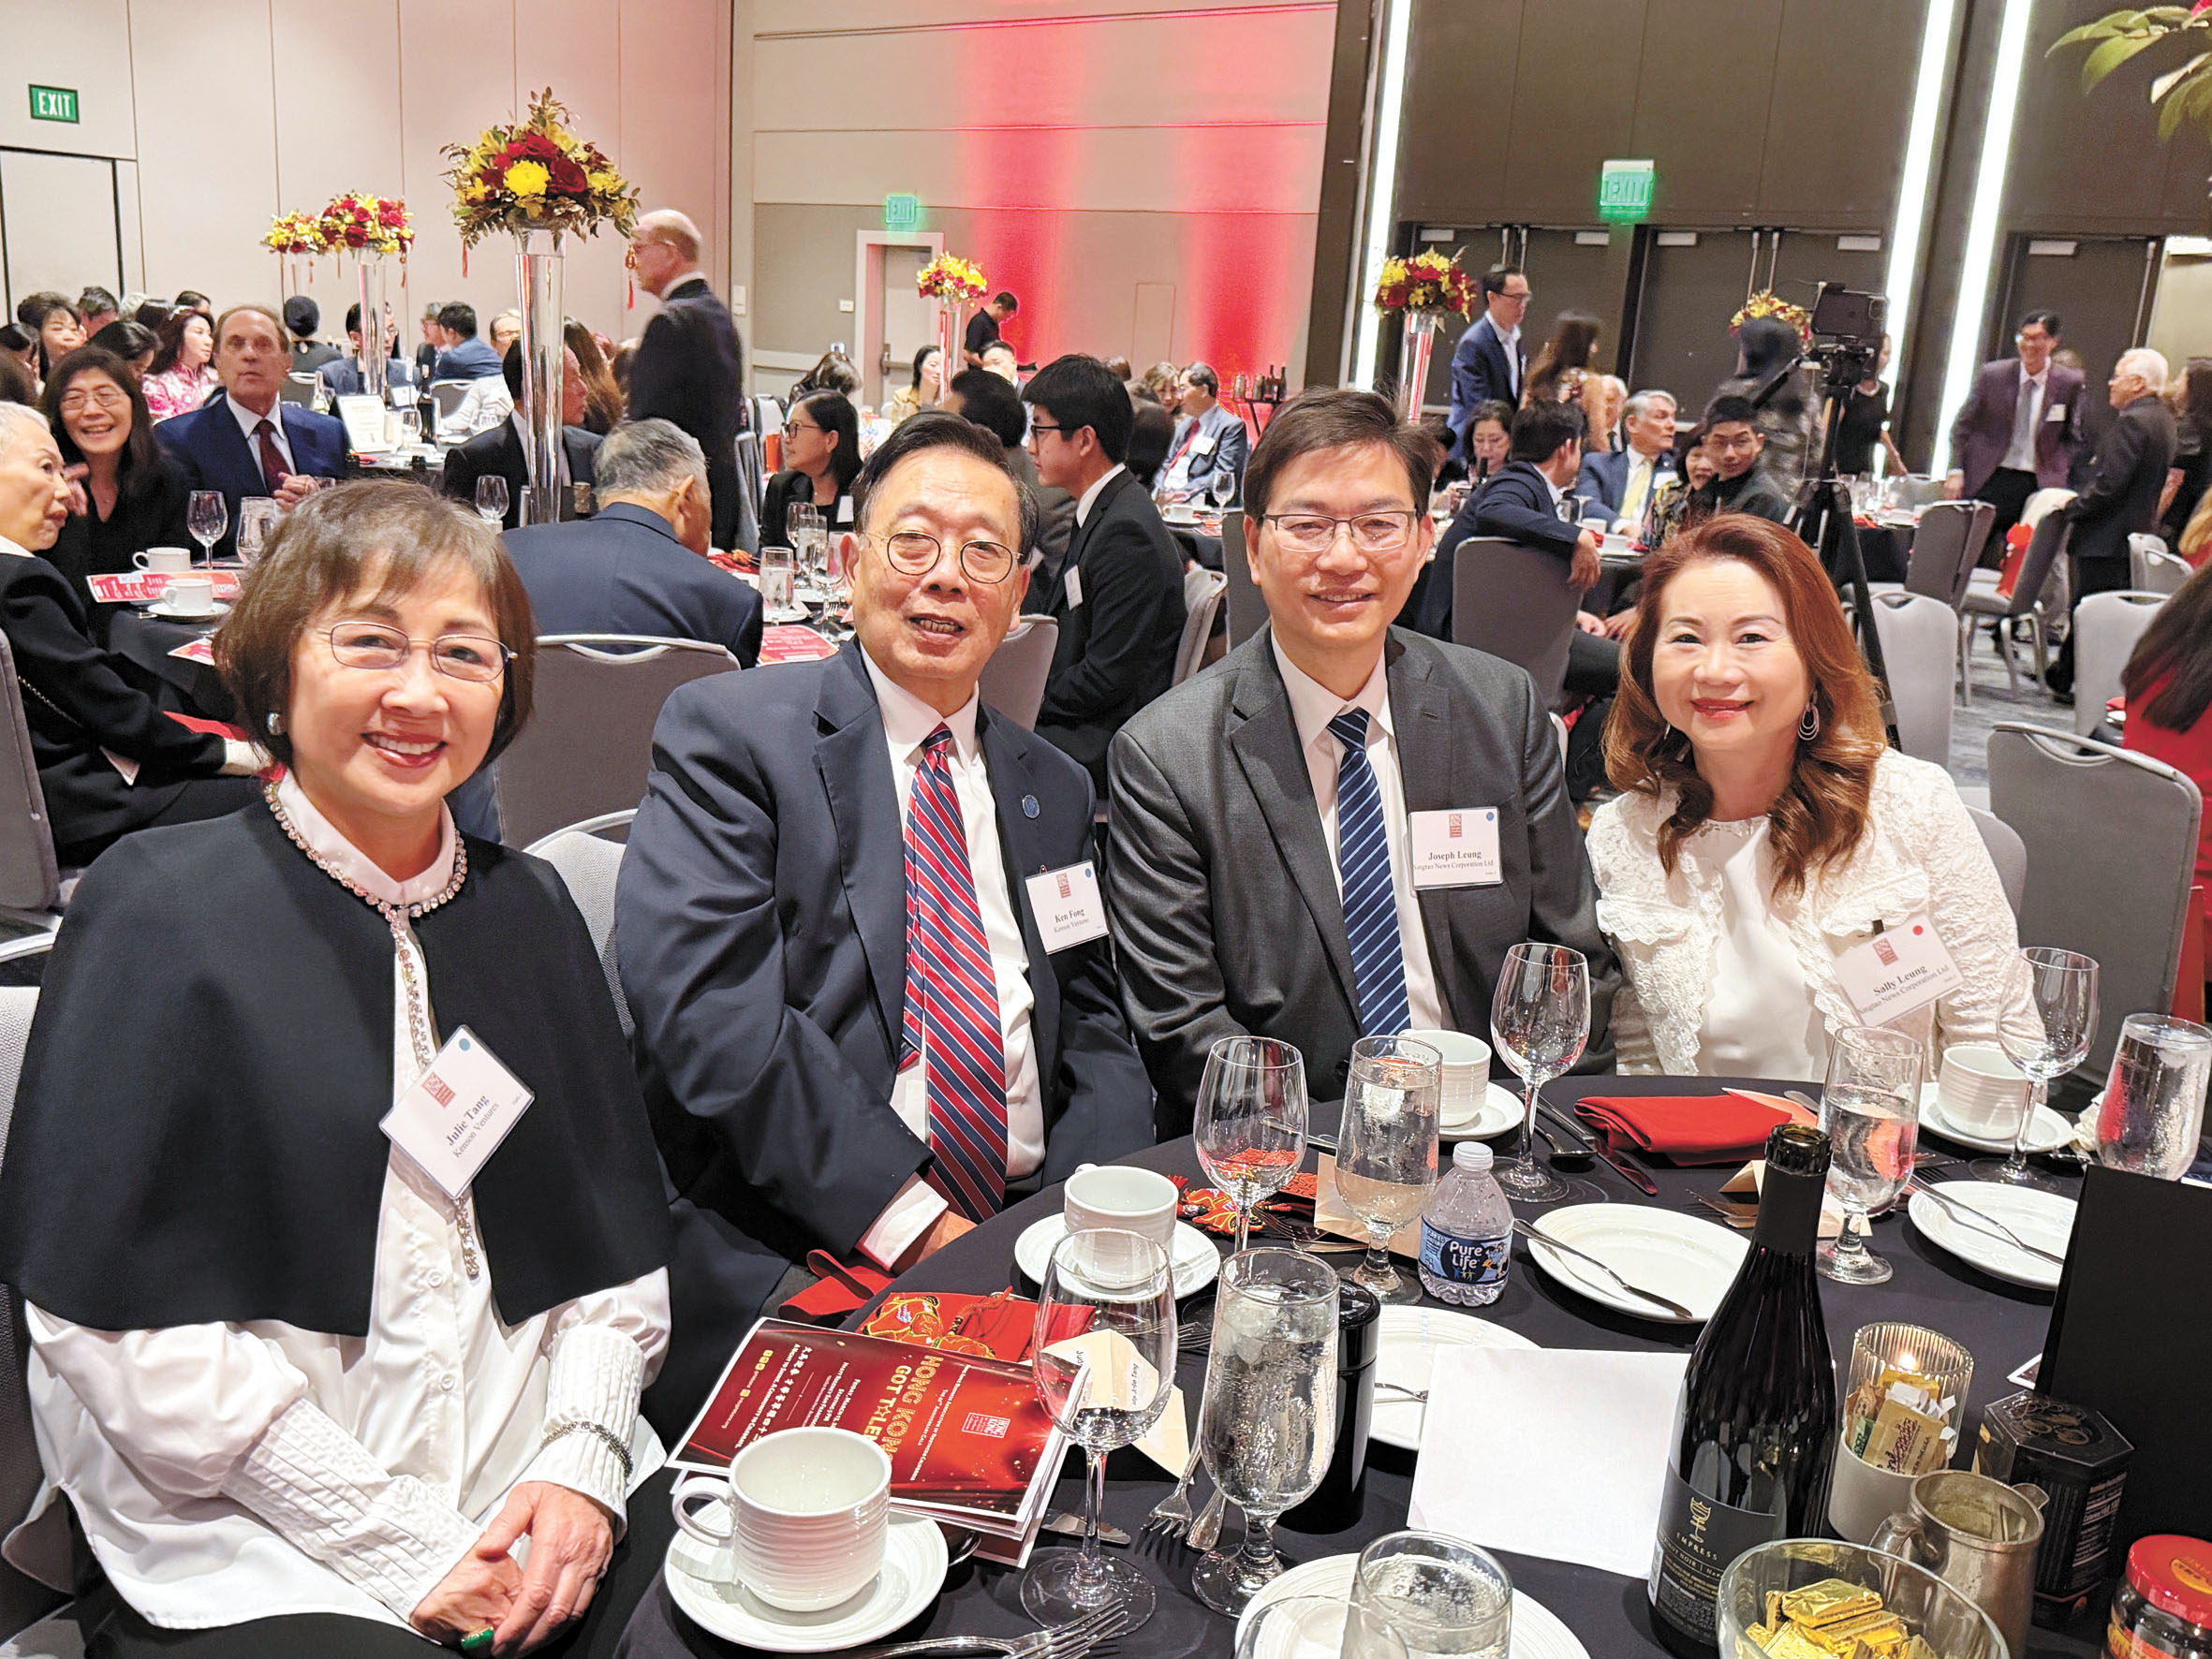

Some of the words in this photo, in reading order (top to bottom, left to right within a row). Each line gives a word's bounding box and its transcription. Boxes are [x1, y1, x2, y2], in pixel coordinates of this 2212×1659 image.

[38, 91, 71, 117] EXIT
[1428, 851, 1455, 862] Joseph
[1457, 850, 1482, 859] Leung
[1873, 980, 1896, 996] Sally
[1896, 965, 1927, 984] Leung
[446, 1121, 469, 1146] Julie
[464, 1094, 491, 1120] Tang
[1450, 1241, 1483, 1256] Pure
[1452, 1254, 1478, 1270] Life
[886, 1365, 912, 1394] GOT
[902, 1355, 944, 1404] HONG
[1676, 1532, 1718, 1561] EMPRESS
[1679, 1552, 1697, 1568] NOIR
